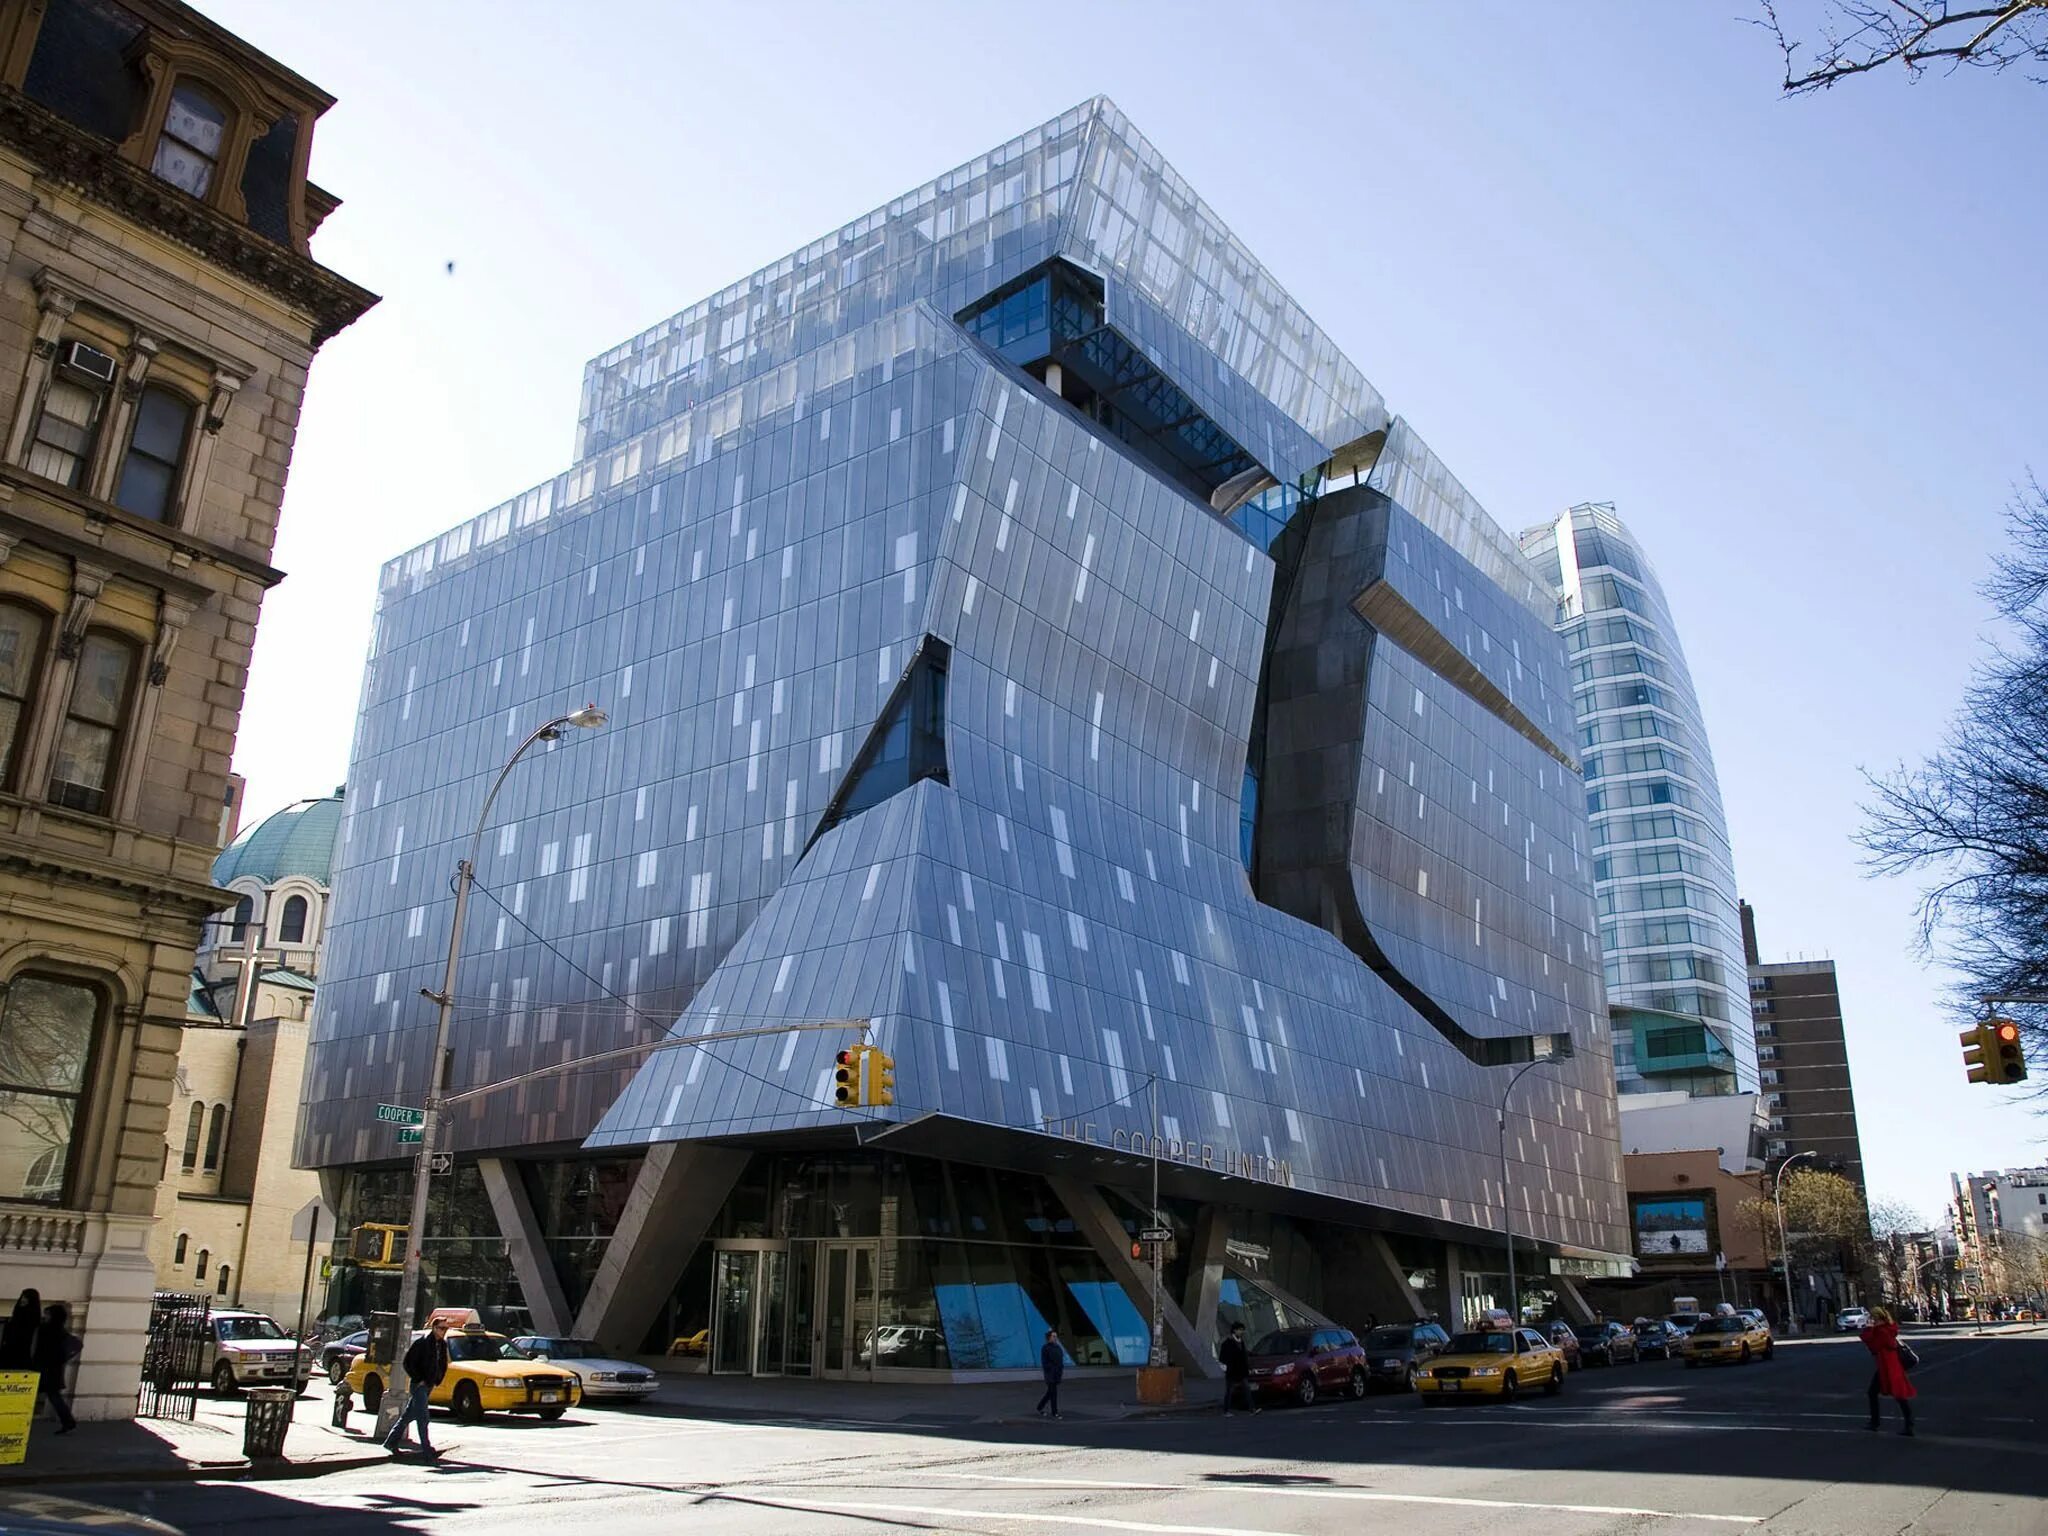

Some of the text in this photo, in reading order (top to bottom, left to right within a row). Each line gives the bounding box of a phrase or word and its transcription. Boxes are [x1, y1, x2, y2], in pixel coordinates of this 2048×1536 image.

[379, 1106, 412, 1122] COOPER
[402, 1130, 408, 1141] E
[409, 1130, 415, 1141] 7
[1041, 1115, 1292, 1188] THE COOPER UNION
